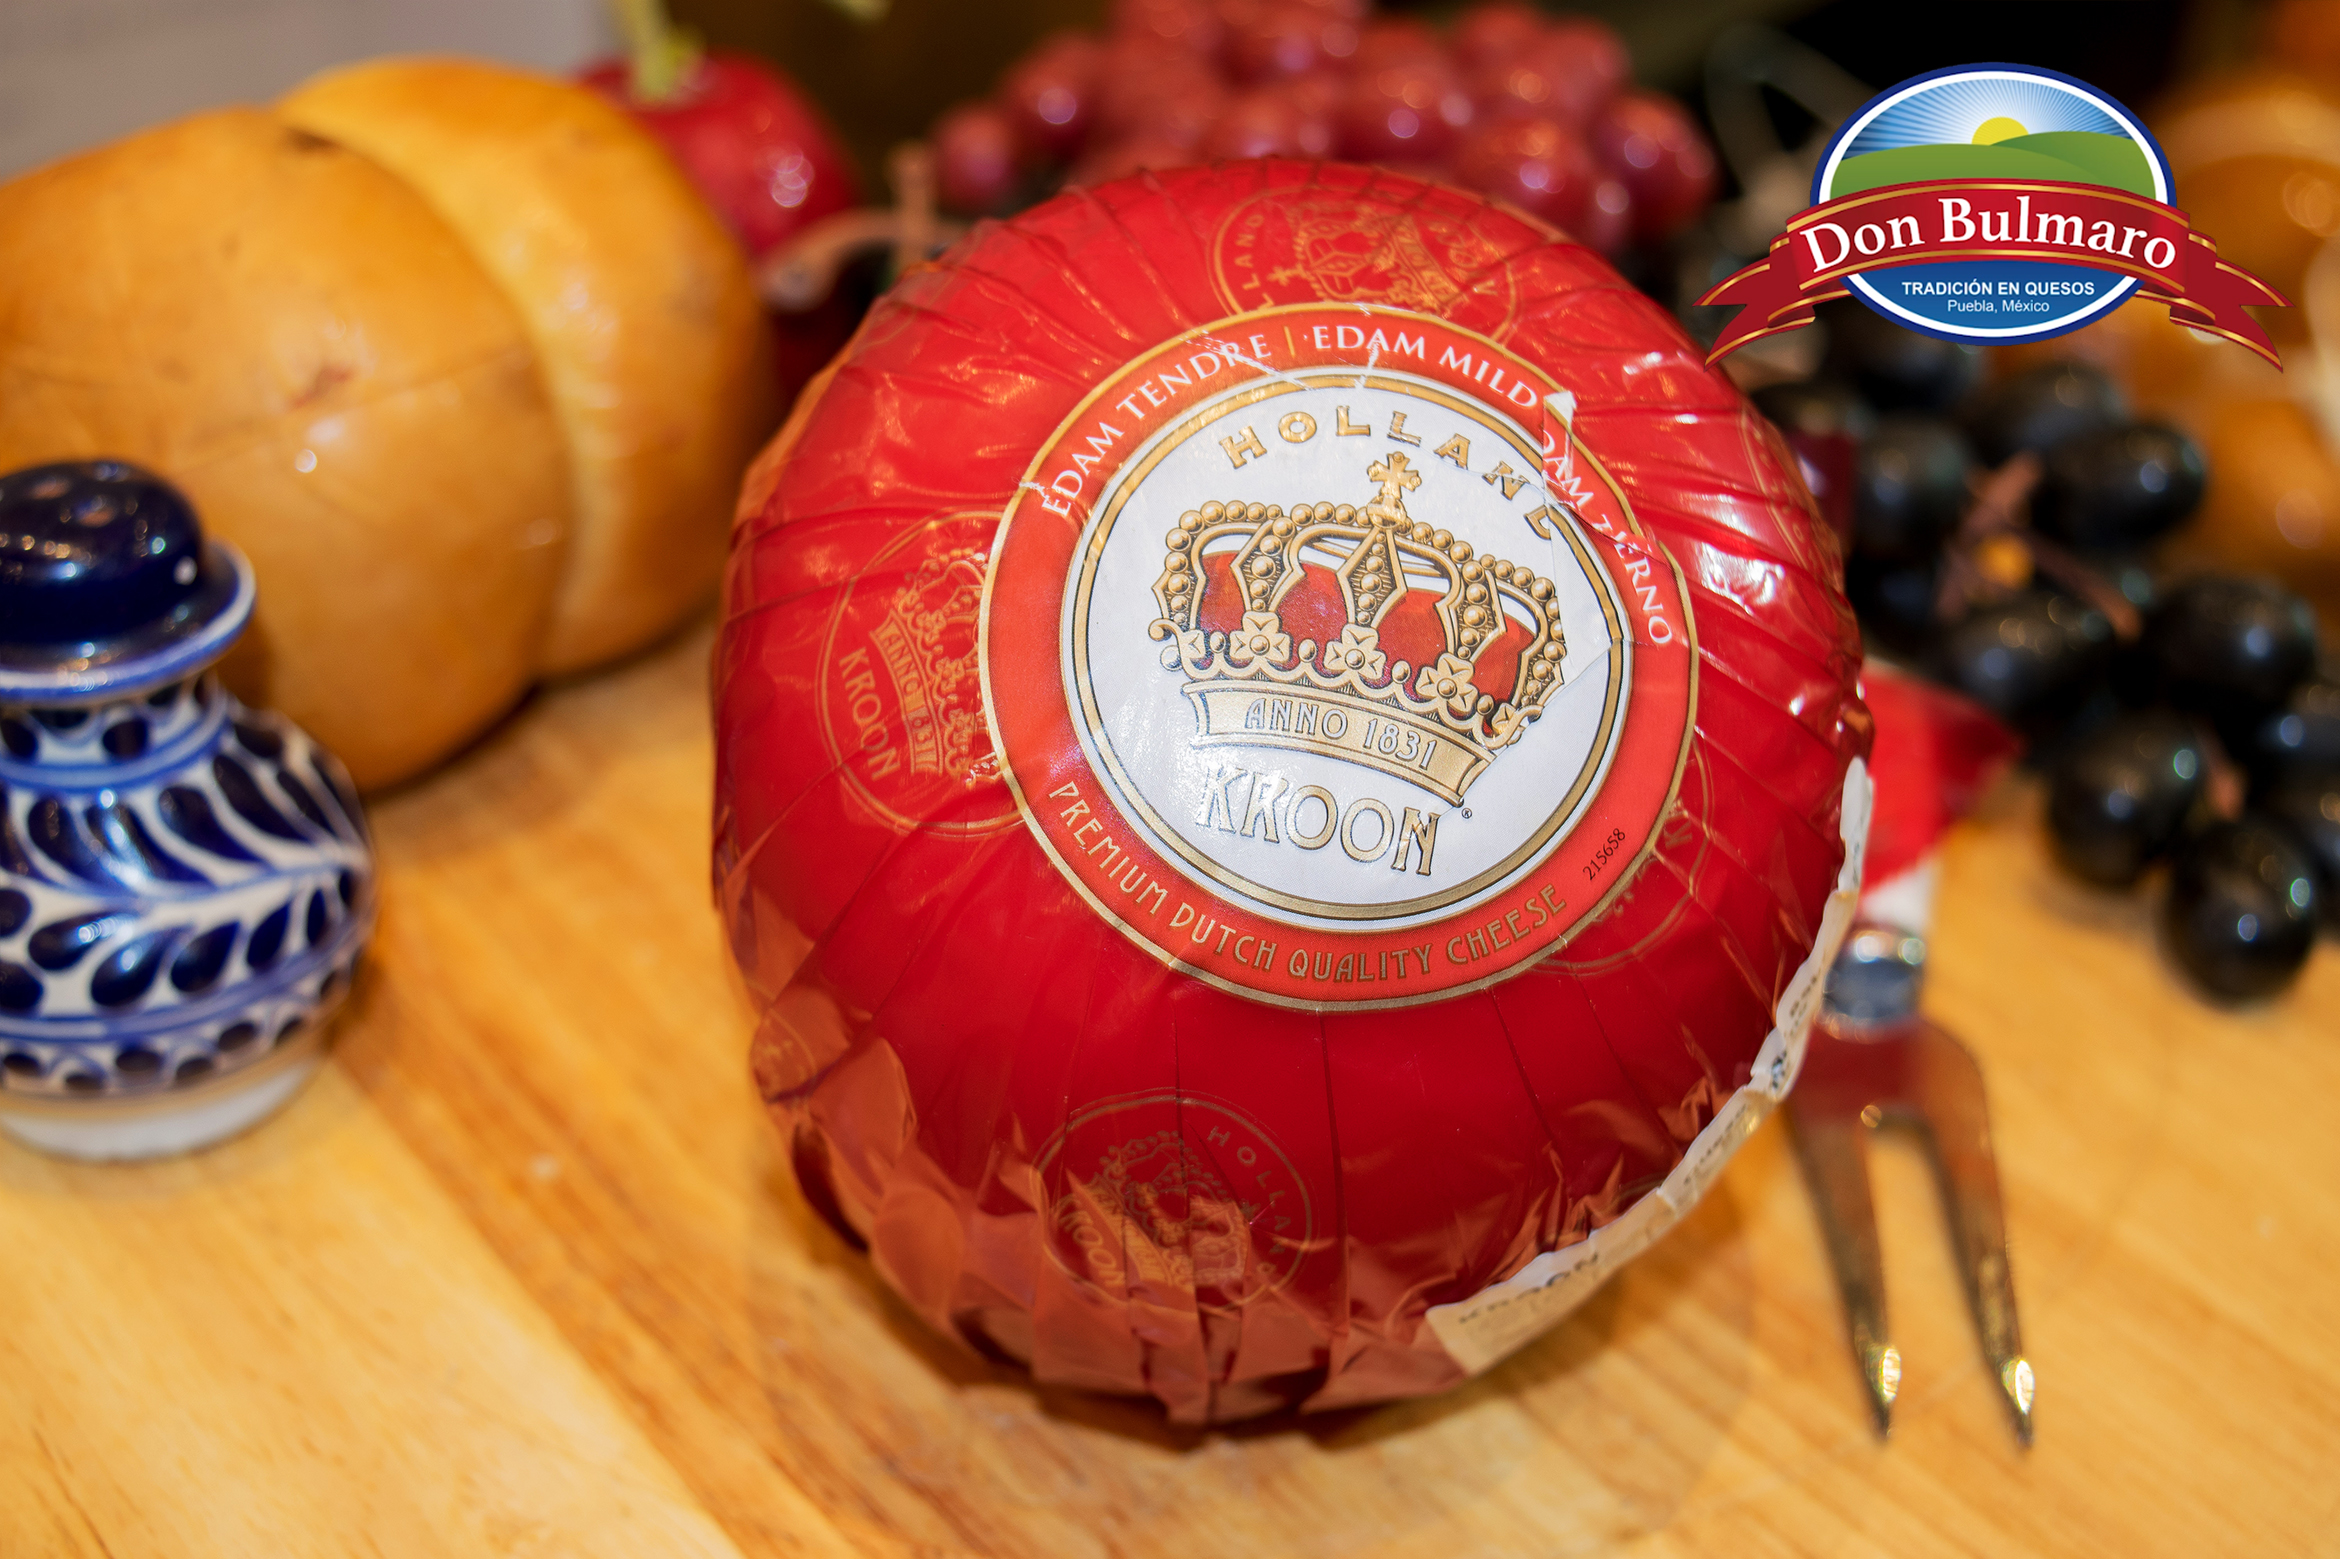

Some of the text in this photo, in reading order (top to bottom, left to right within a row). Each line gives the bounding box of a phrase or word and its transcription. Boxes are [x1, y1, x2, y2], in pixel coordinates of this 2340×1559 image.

[1042, 325, 1539, 516] EDAM TENDRE EDAM MILD
[1218, 405, 1551, 541] HOLLAND
[1543, 429, 1594, 509] DAM
[839, 646, 901, 781] KROON
[1244, 697, 1439, 771] ANNO 1831
[1048, 780, 1567, 984] PREMIUM DUTCH QUALITY CHEESE
[1195, 764, 1441, 877] KROON
[1582, 827, 1627, 881] 215658
